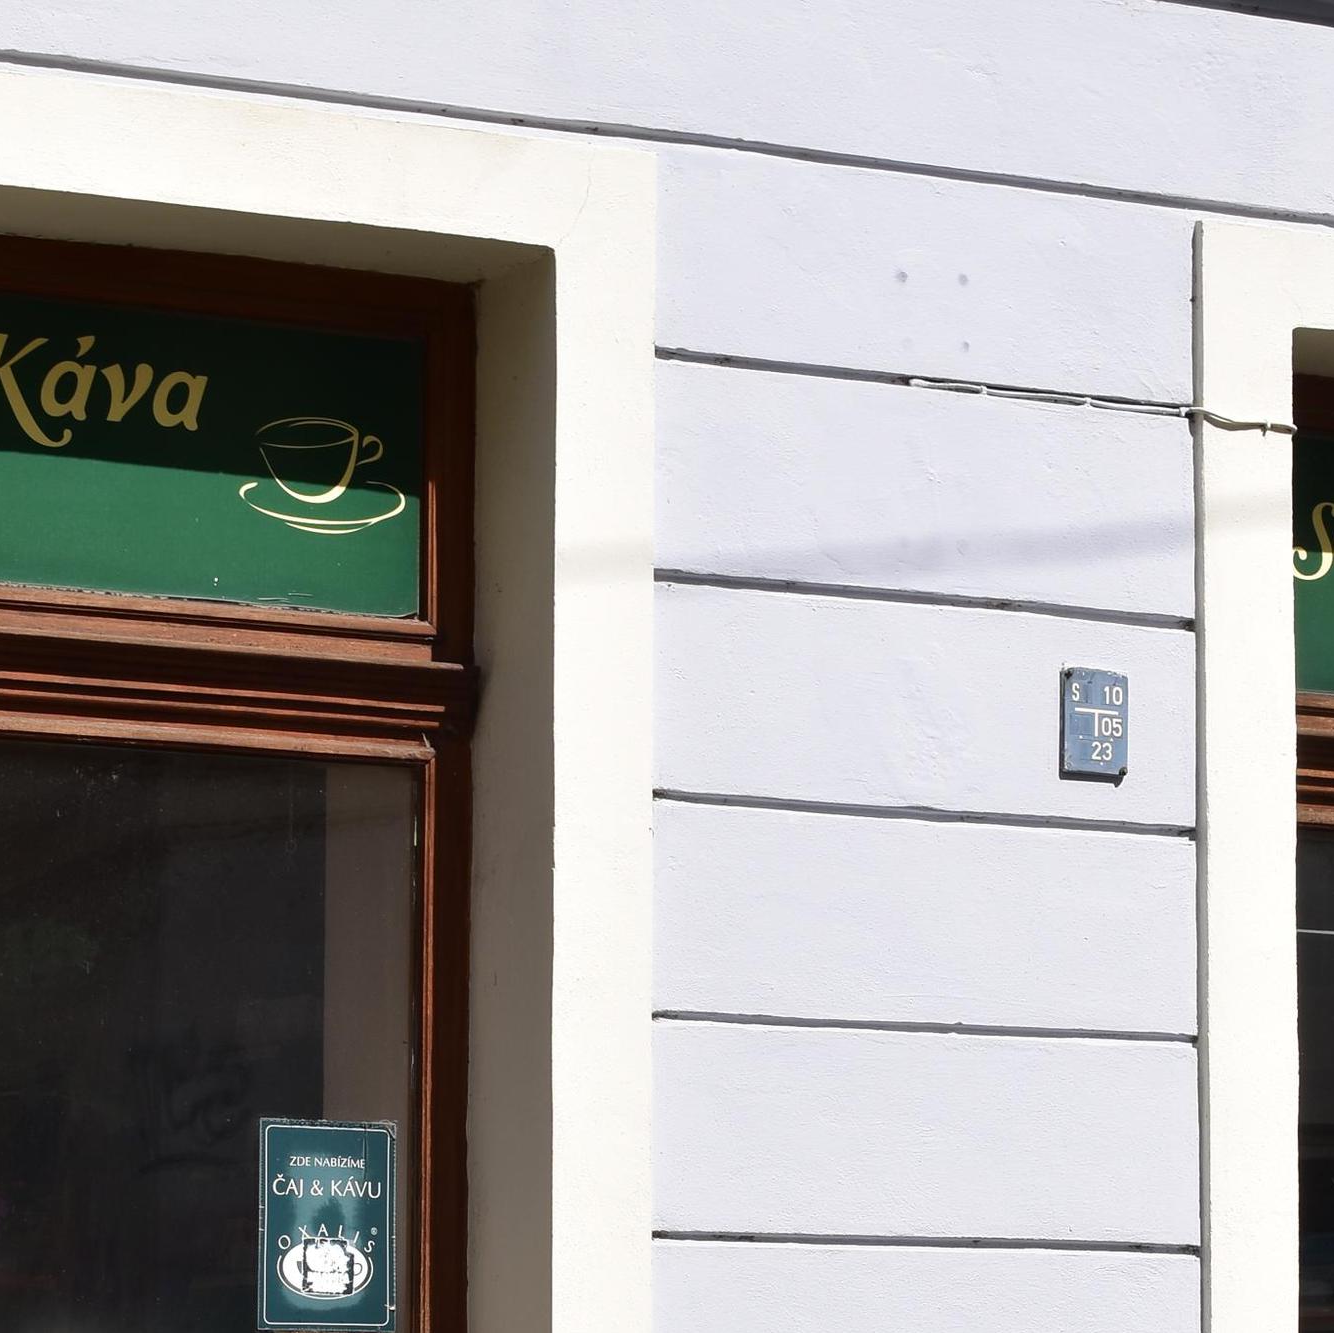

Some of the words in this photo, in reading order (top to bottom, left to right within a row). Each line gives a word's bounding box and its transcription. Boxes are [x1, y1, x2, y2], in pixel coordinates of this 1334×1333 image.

[1104, 686, 1123, 705] 10
[1091, 741, 1112, 761] 23
[289, 1156, 311, 1167] ZDE
[314, 1156, 366, 1169] NABÍZÍME
[272, 1174, 304, 1198] ČAJ
[310, 1179, 324, 1196] &
[331, 1176, 381, 1199] KÁVU
